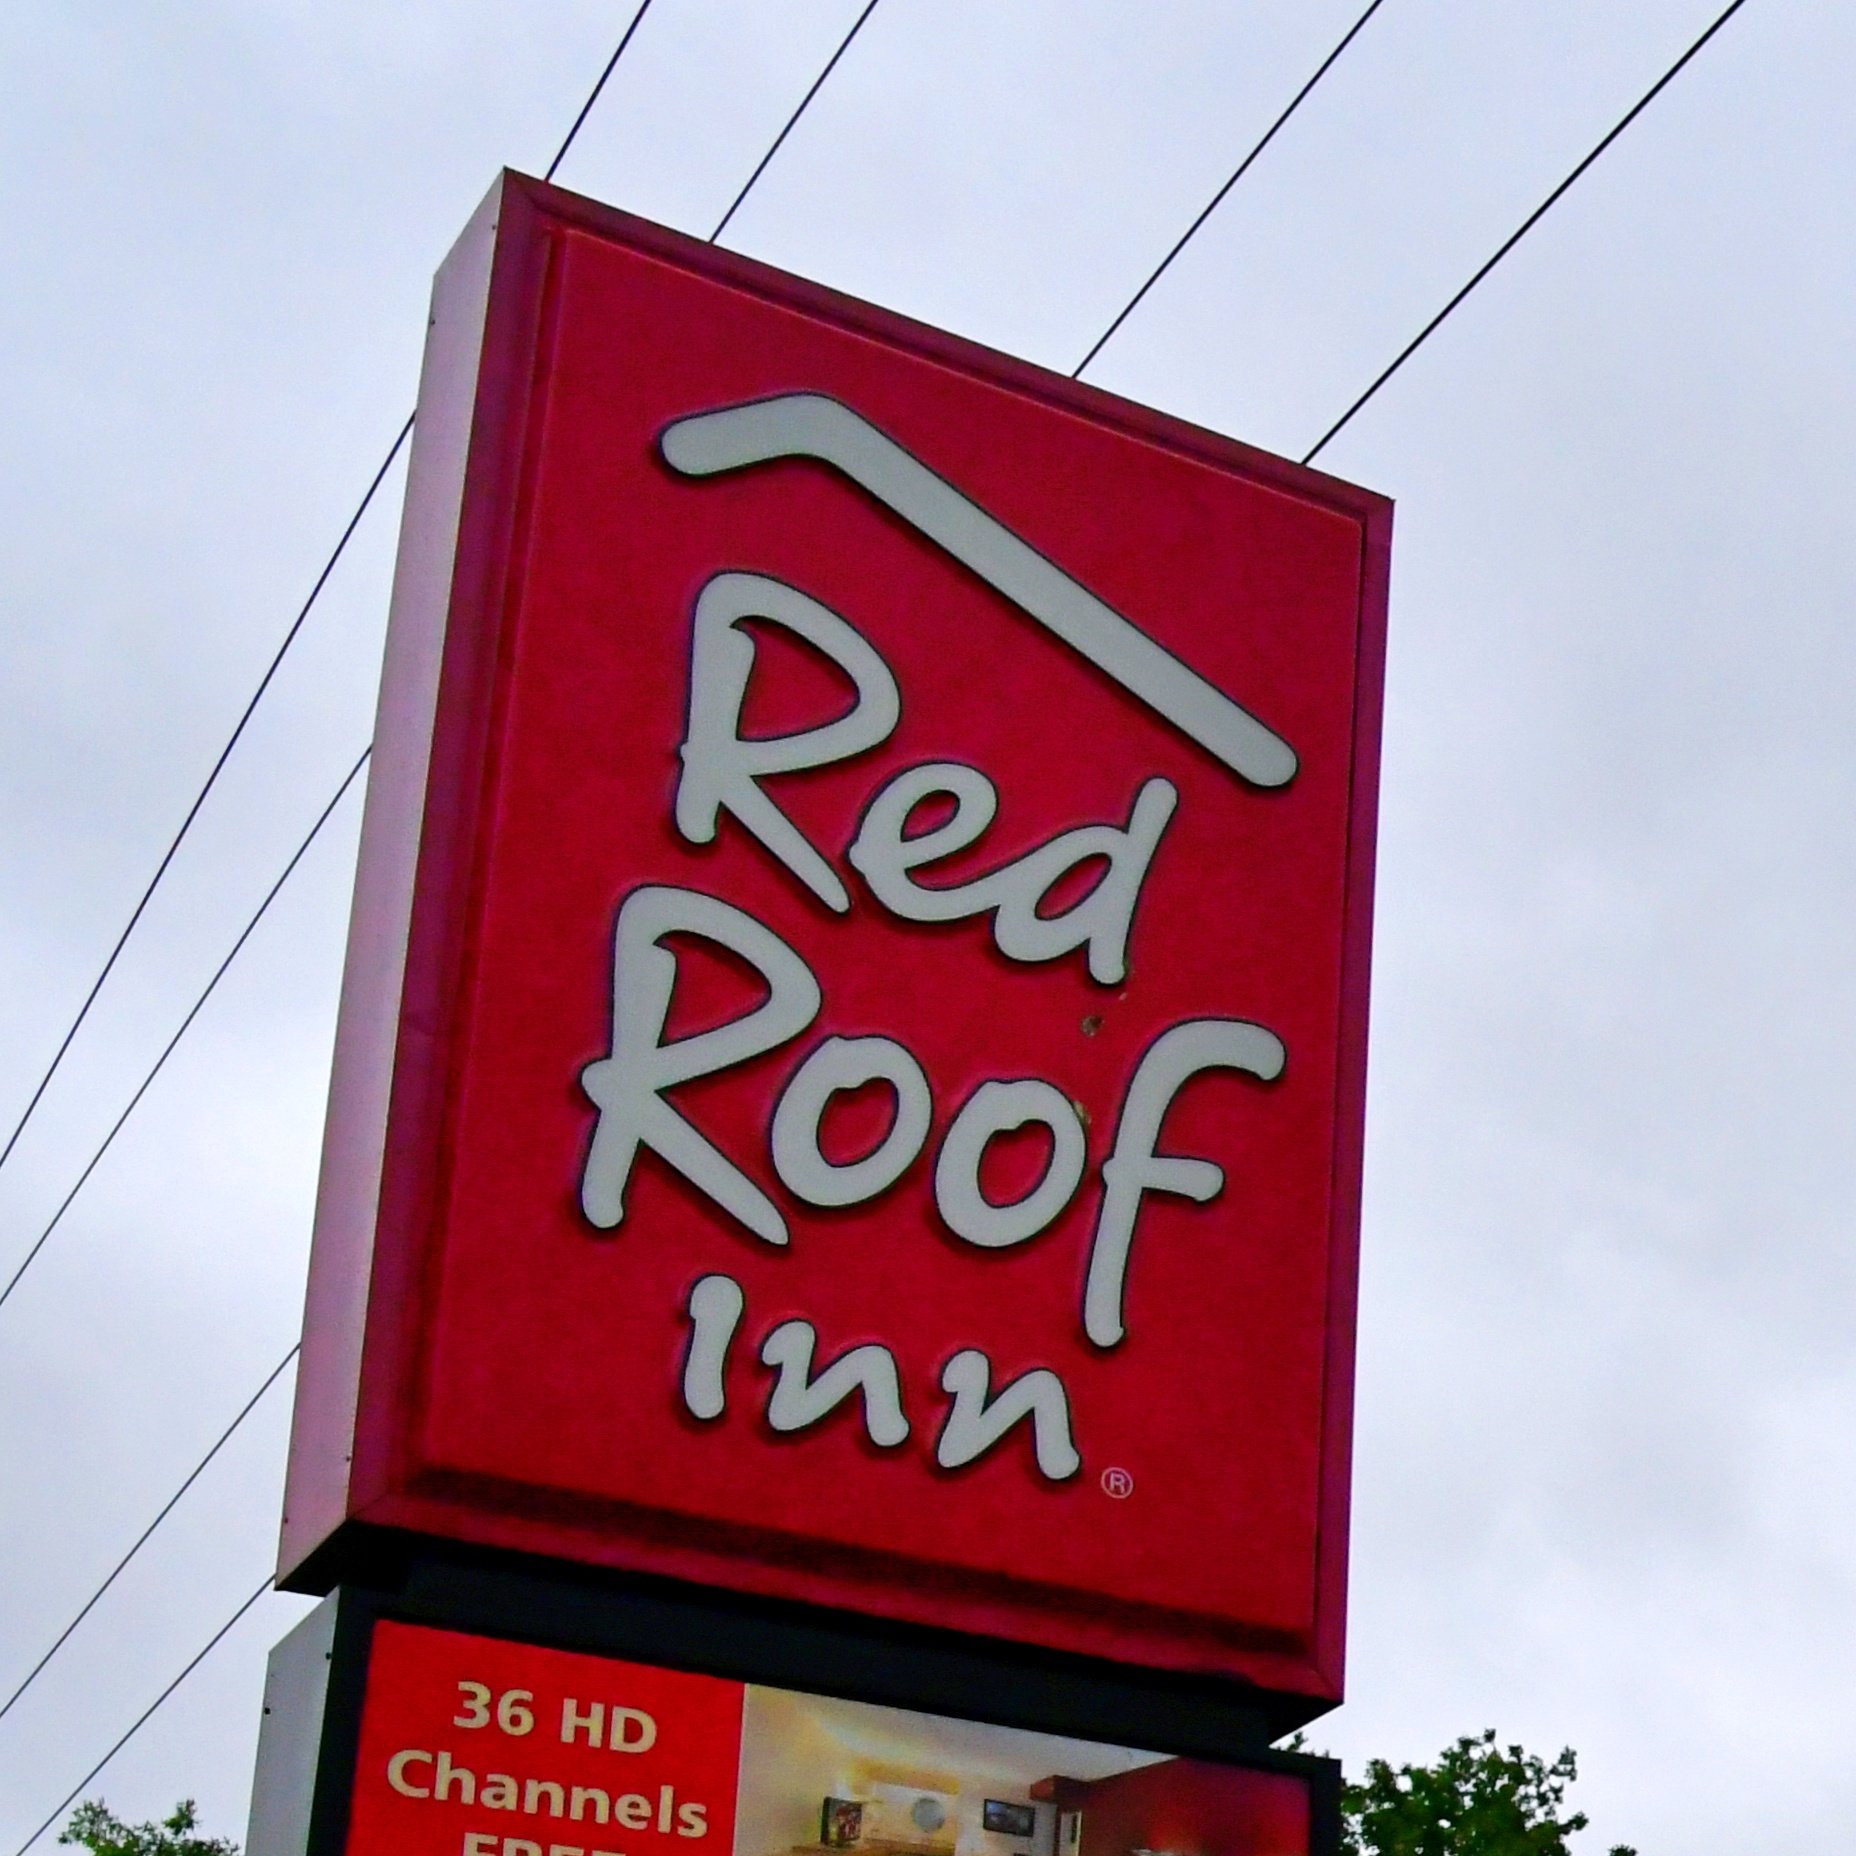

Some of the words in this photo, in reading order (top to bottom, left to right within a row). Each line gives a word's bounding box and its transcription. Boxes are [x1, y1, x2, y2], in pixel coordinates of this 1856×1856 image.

[674, 570, 1179, 986] Red
[580, 885, 1286, 1349] Roof
[683, 1273, 1082, 1481] Inn
[387, 1749, 708, 1839] Channels
[453, 1680, 535, 1737] 36
[560, 1698, 657, 1753] HD
